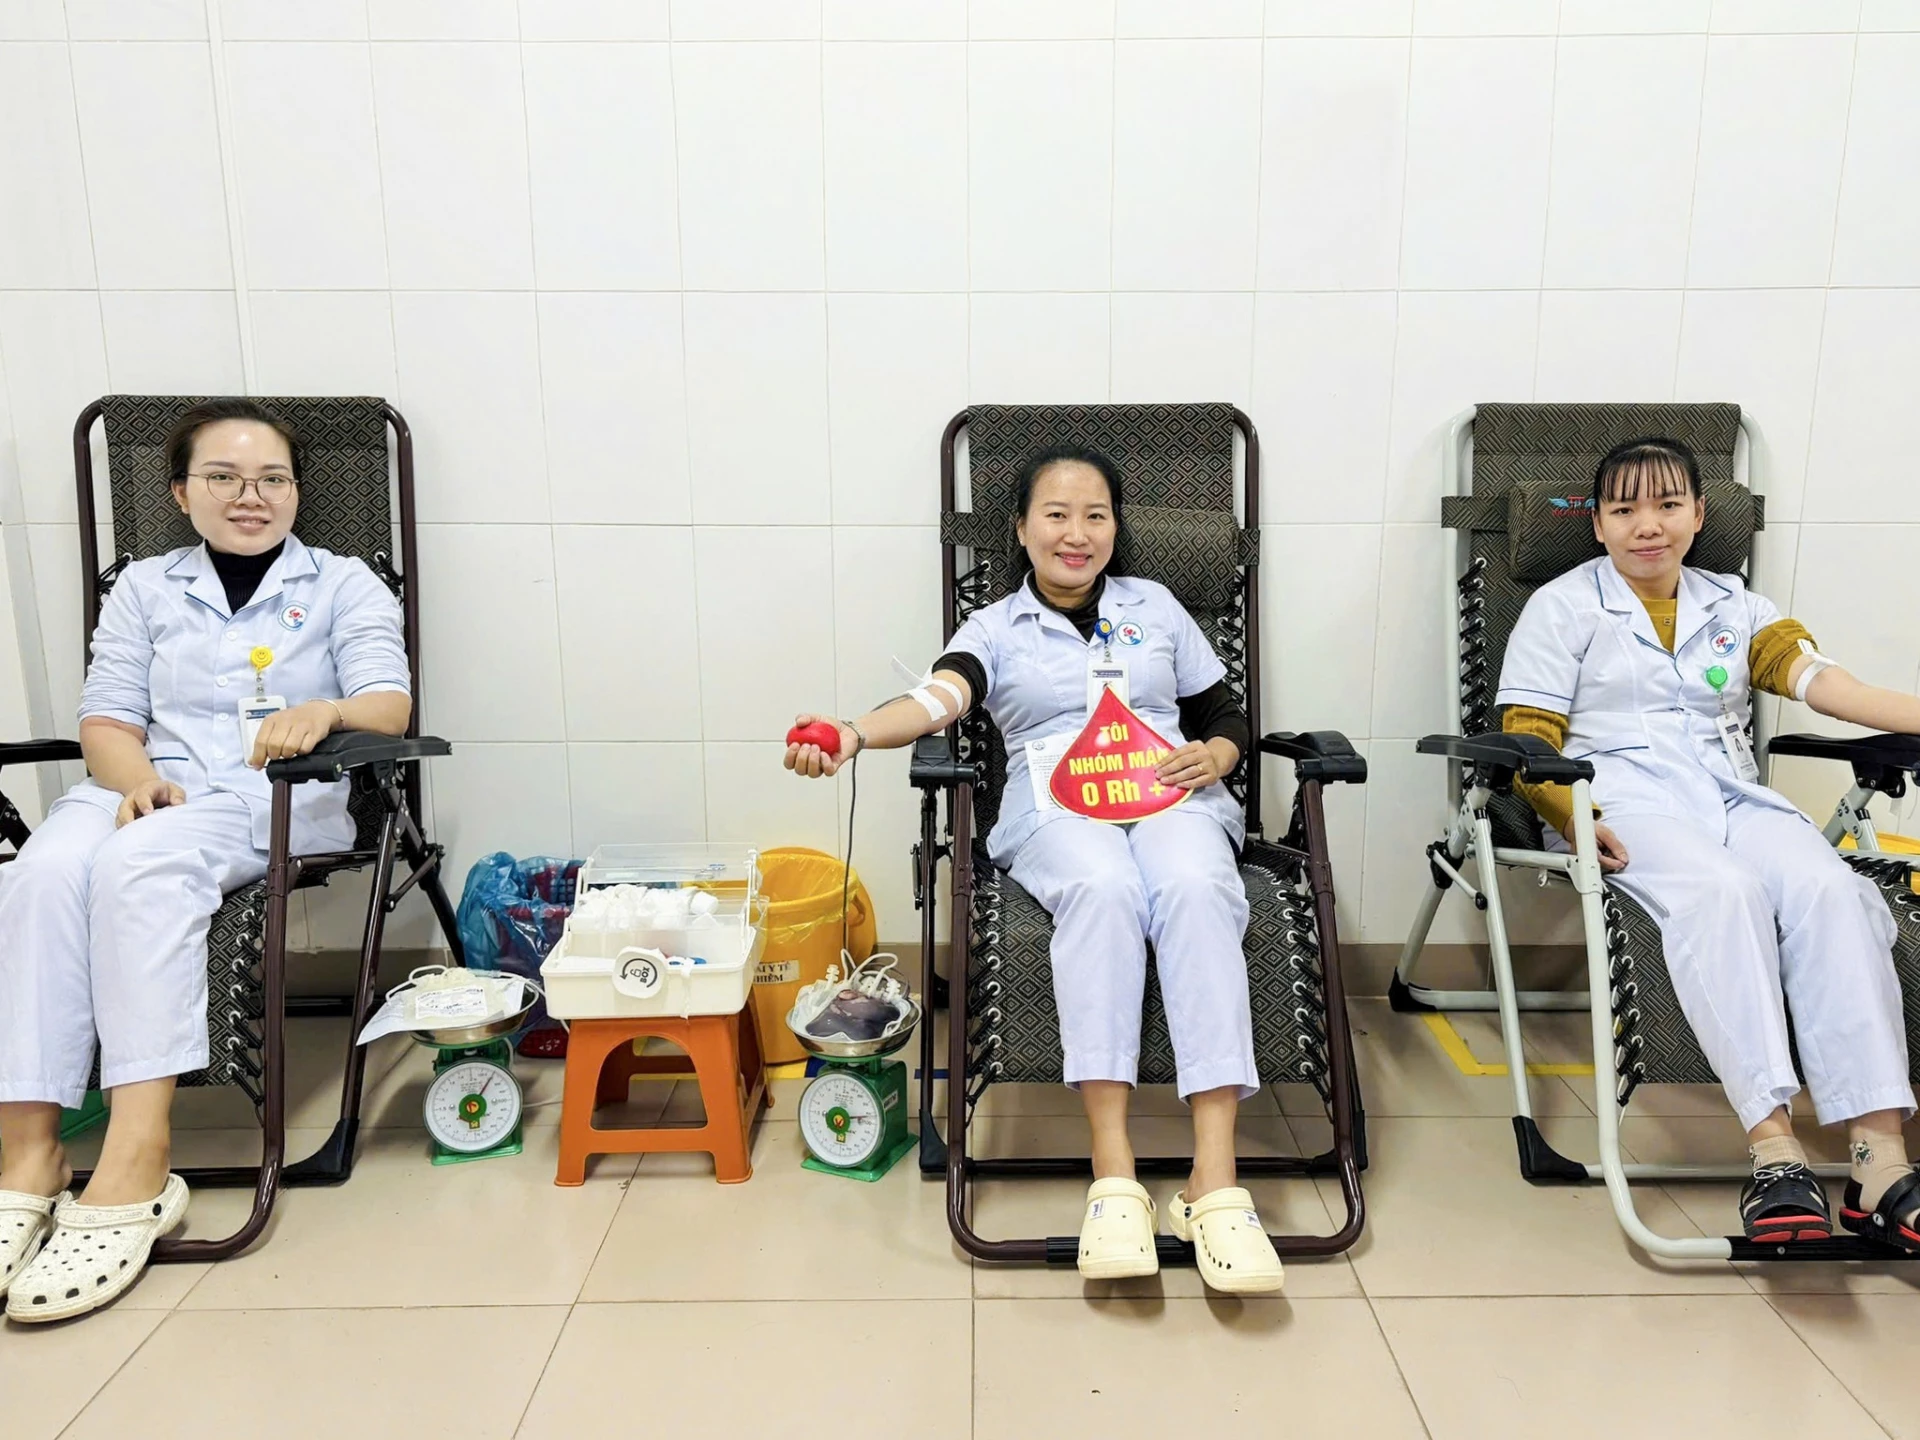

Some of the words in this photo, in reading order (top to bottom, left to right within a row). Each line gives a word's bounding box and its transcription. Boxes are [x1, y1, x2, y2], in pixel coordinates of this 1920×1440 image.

[1099, 721, 1129, 743] TÔI
[1068, 752, 1124, 776] NHÓM
[1105, 778, 1142, 805] Rh
[639, 966, 651, 984] BOX
